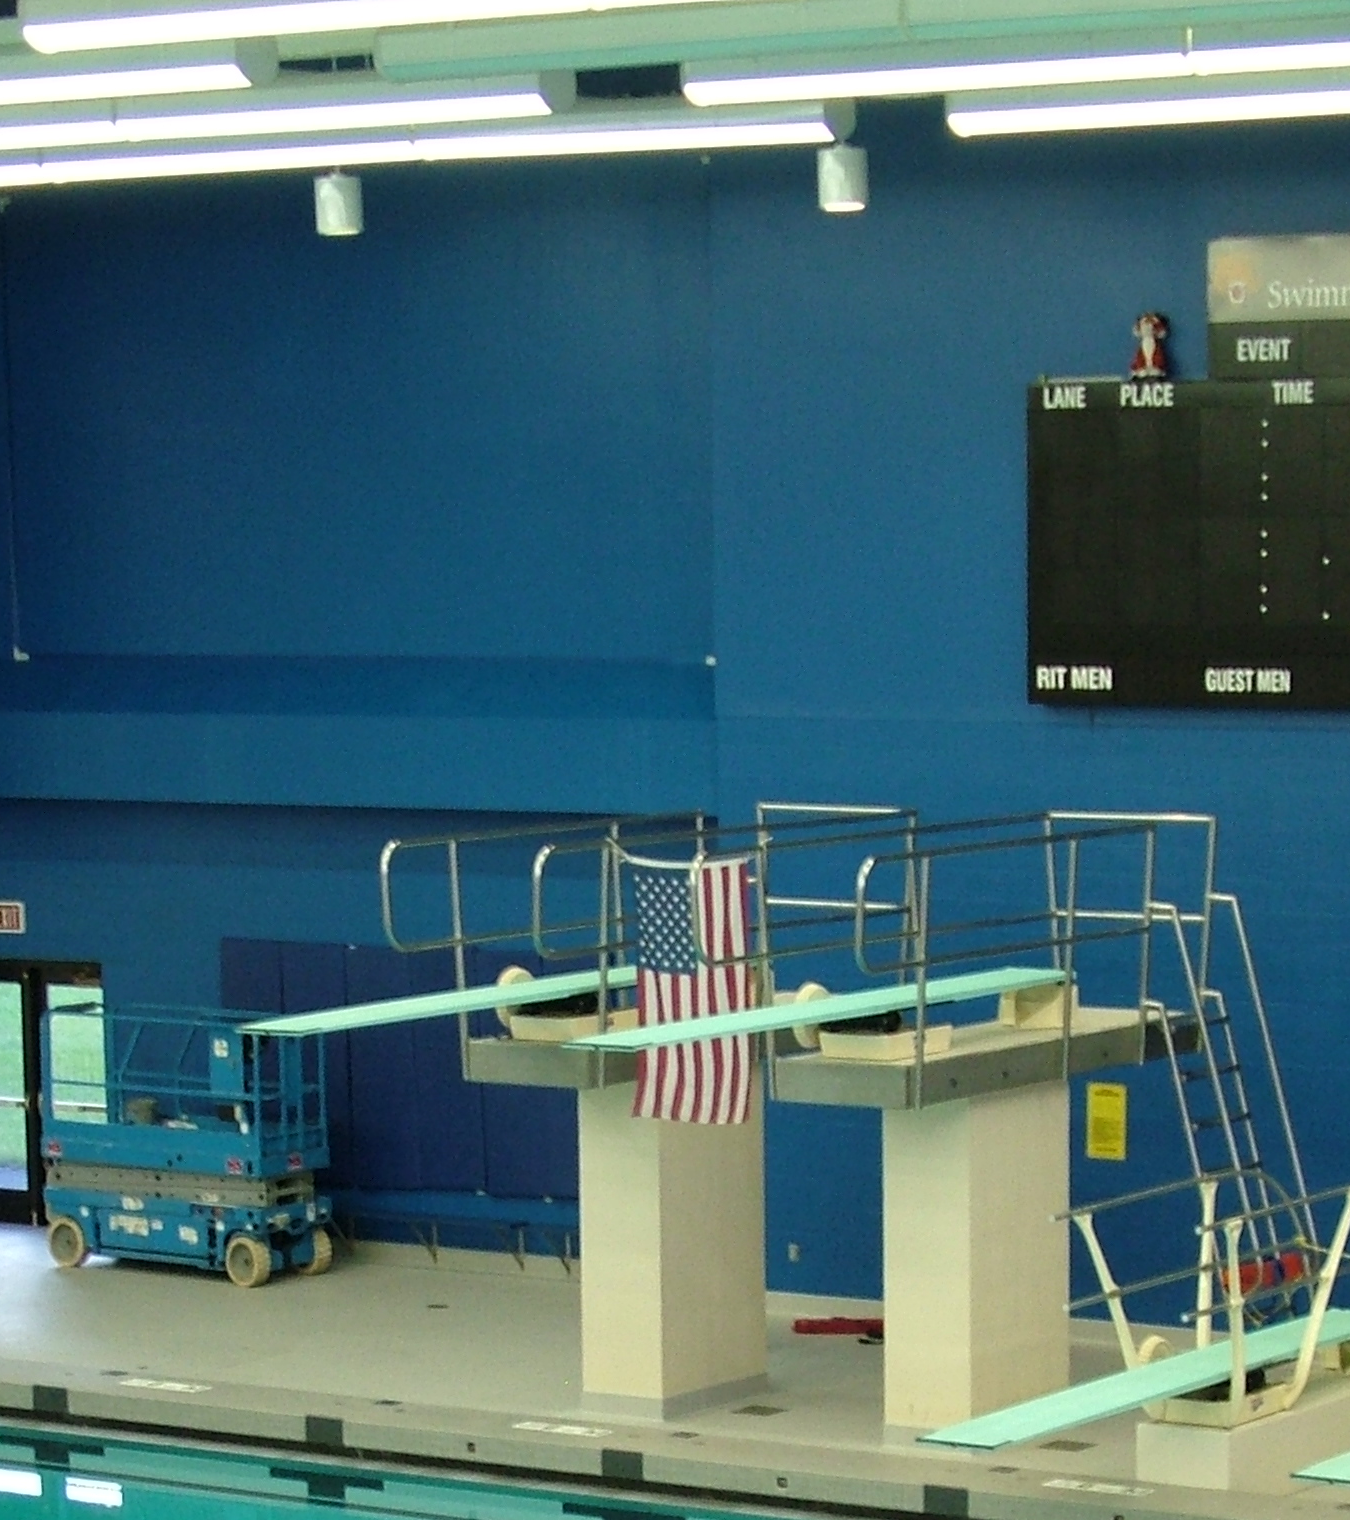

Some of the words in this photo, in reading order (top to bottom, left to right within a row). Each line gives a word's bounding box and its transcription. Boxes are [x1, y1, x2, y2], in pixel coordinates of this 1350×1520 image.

[1236, 338, 1292, 362] EVENT
[1043, 386, 1087, 410] LANE
[1120, 383, 1174, 408] PLACE
[1272, 380, 1315, 405] TIME
[1036, 665, 1067, 690] RIT
[1070, 666, 1113, 691] MEN
[1204, 667, 1252, 693] GUEST
[1256, 668, 1291, 693] MEN
